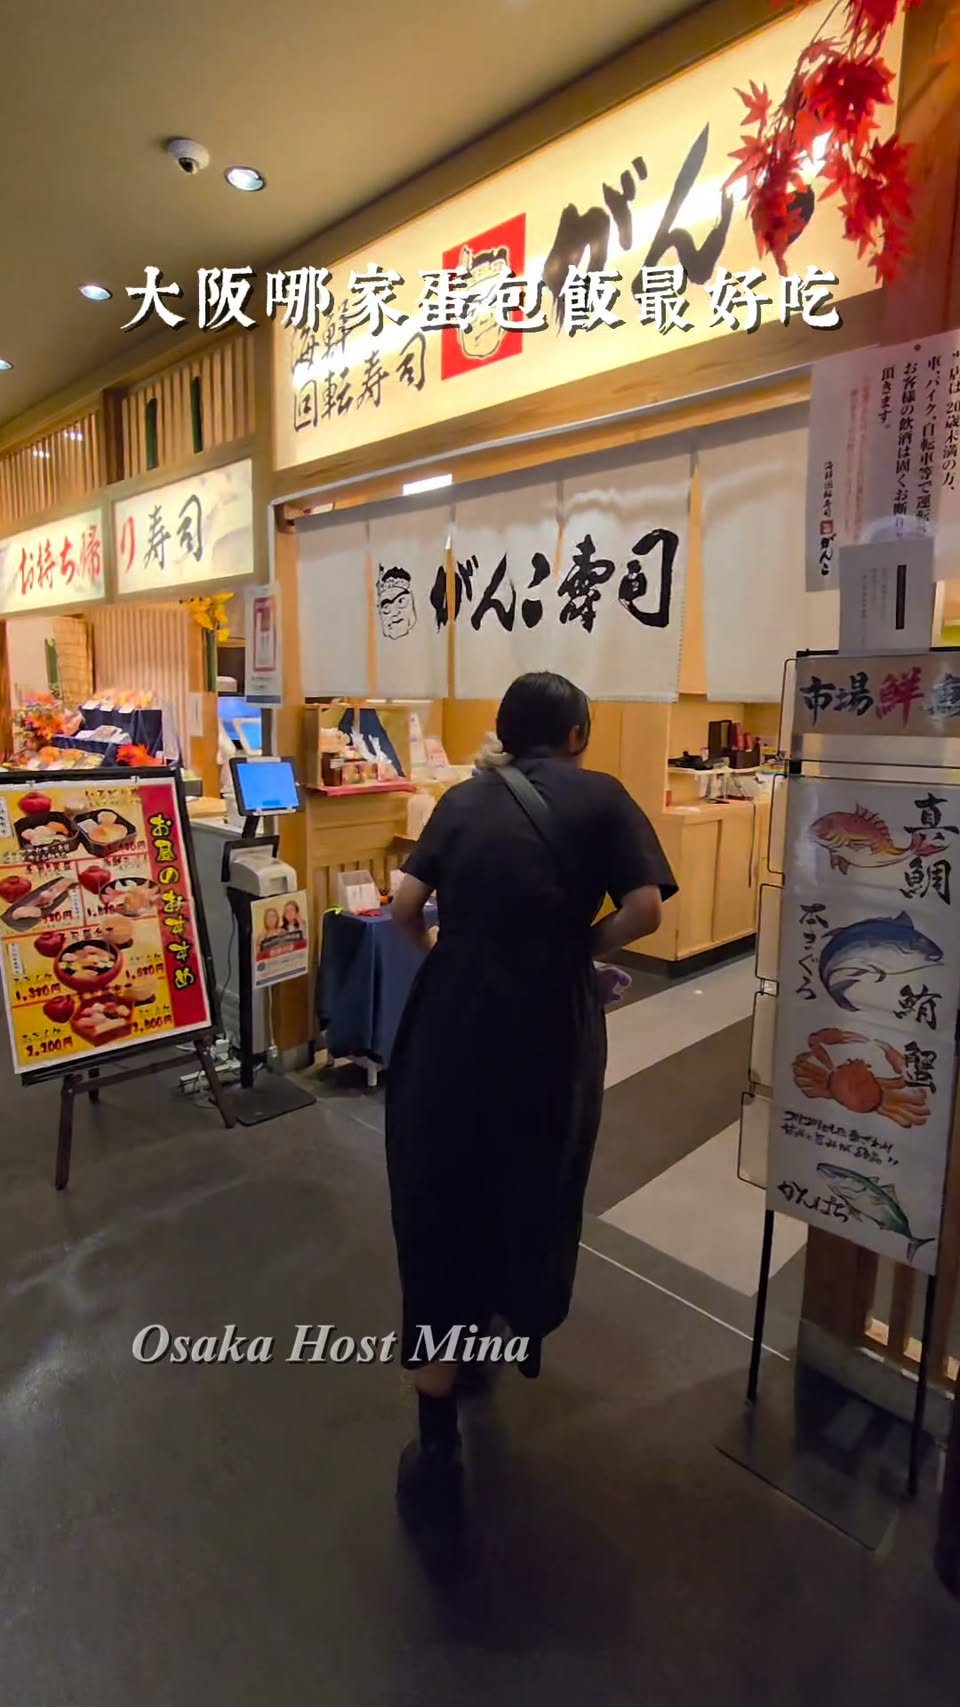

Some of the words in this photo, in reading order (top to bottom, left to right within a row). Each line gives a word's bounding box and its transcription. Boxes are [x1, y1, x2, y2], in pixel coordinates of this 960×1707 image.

[293, 331, 427, 432] 回転寿司
[148, 813, 196, 991] お昼のおすすめ
[899, 792, 960, 905] 真鯛
[893, 984, 943, 1031] 鮪
